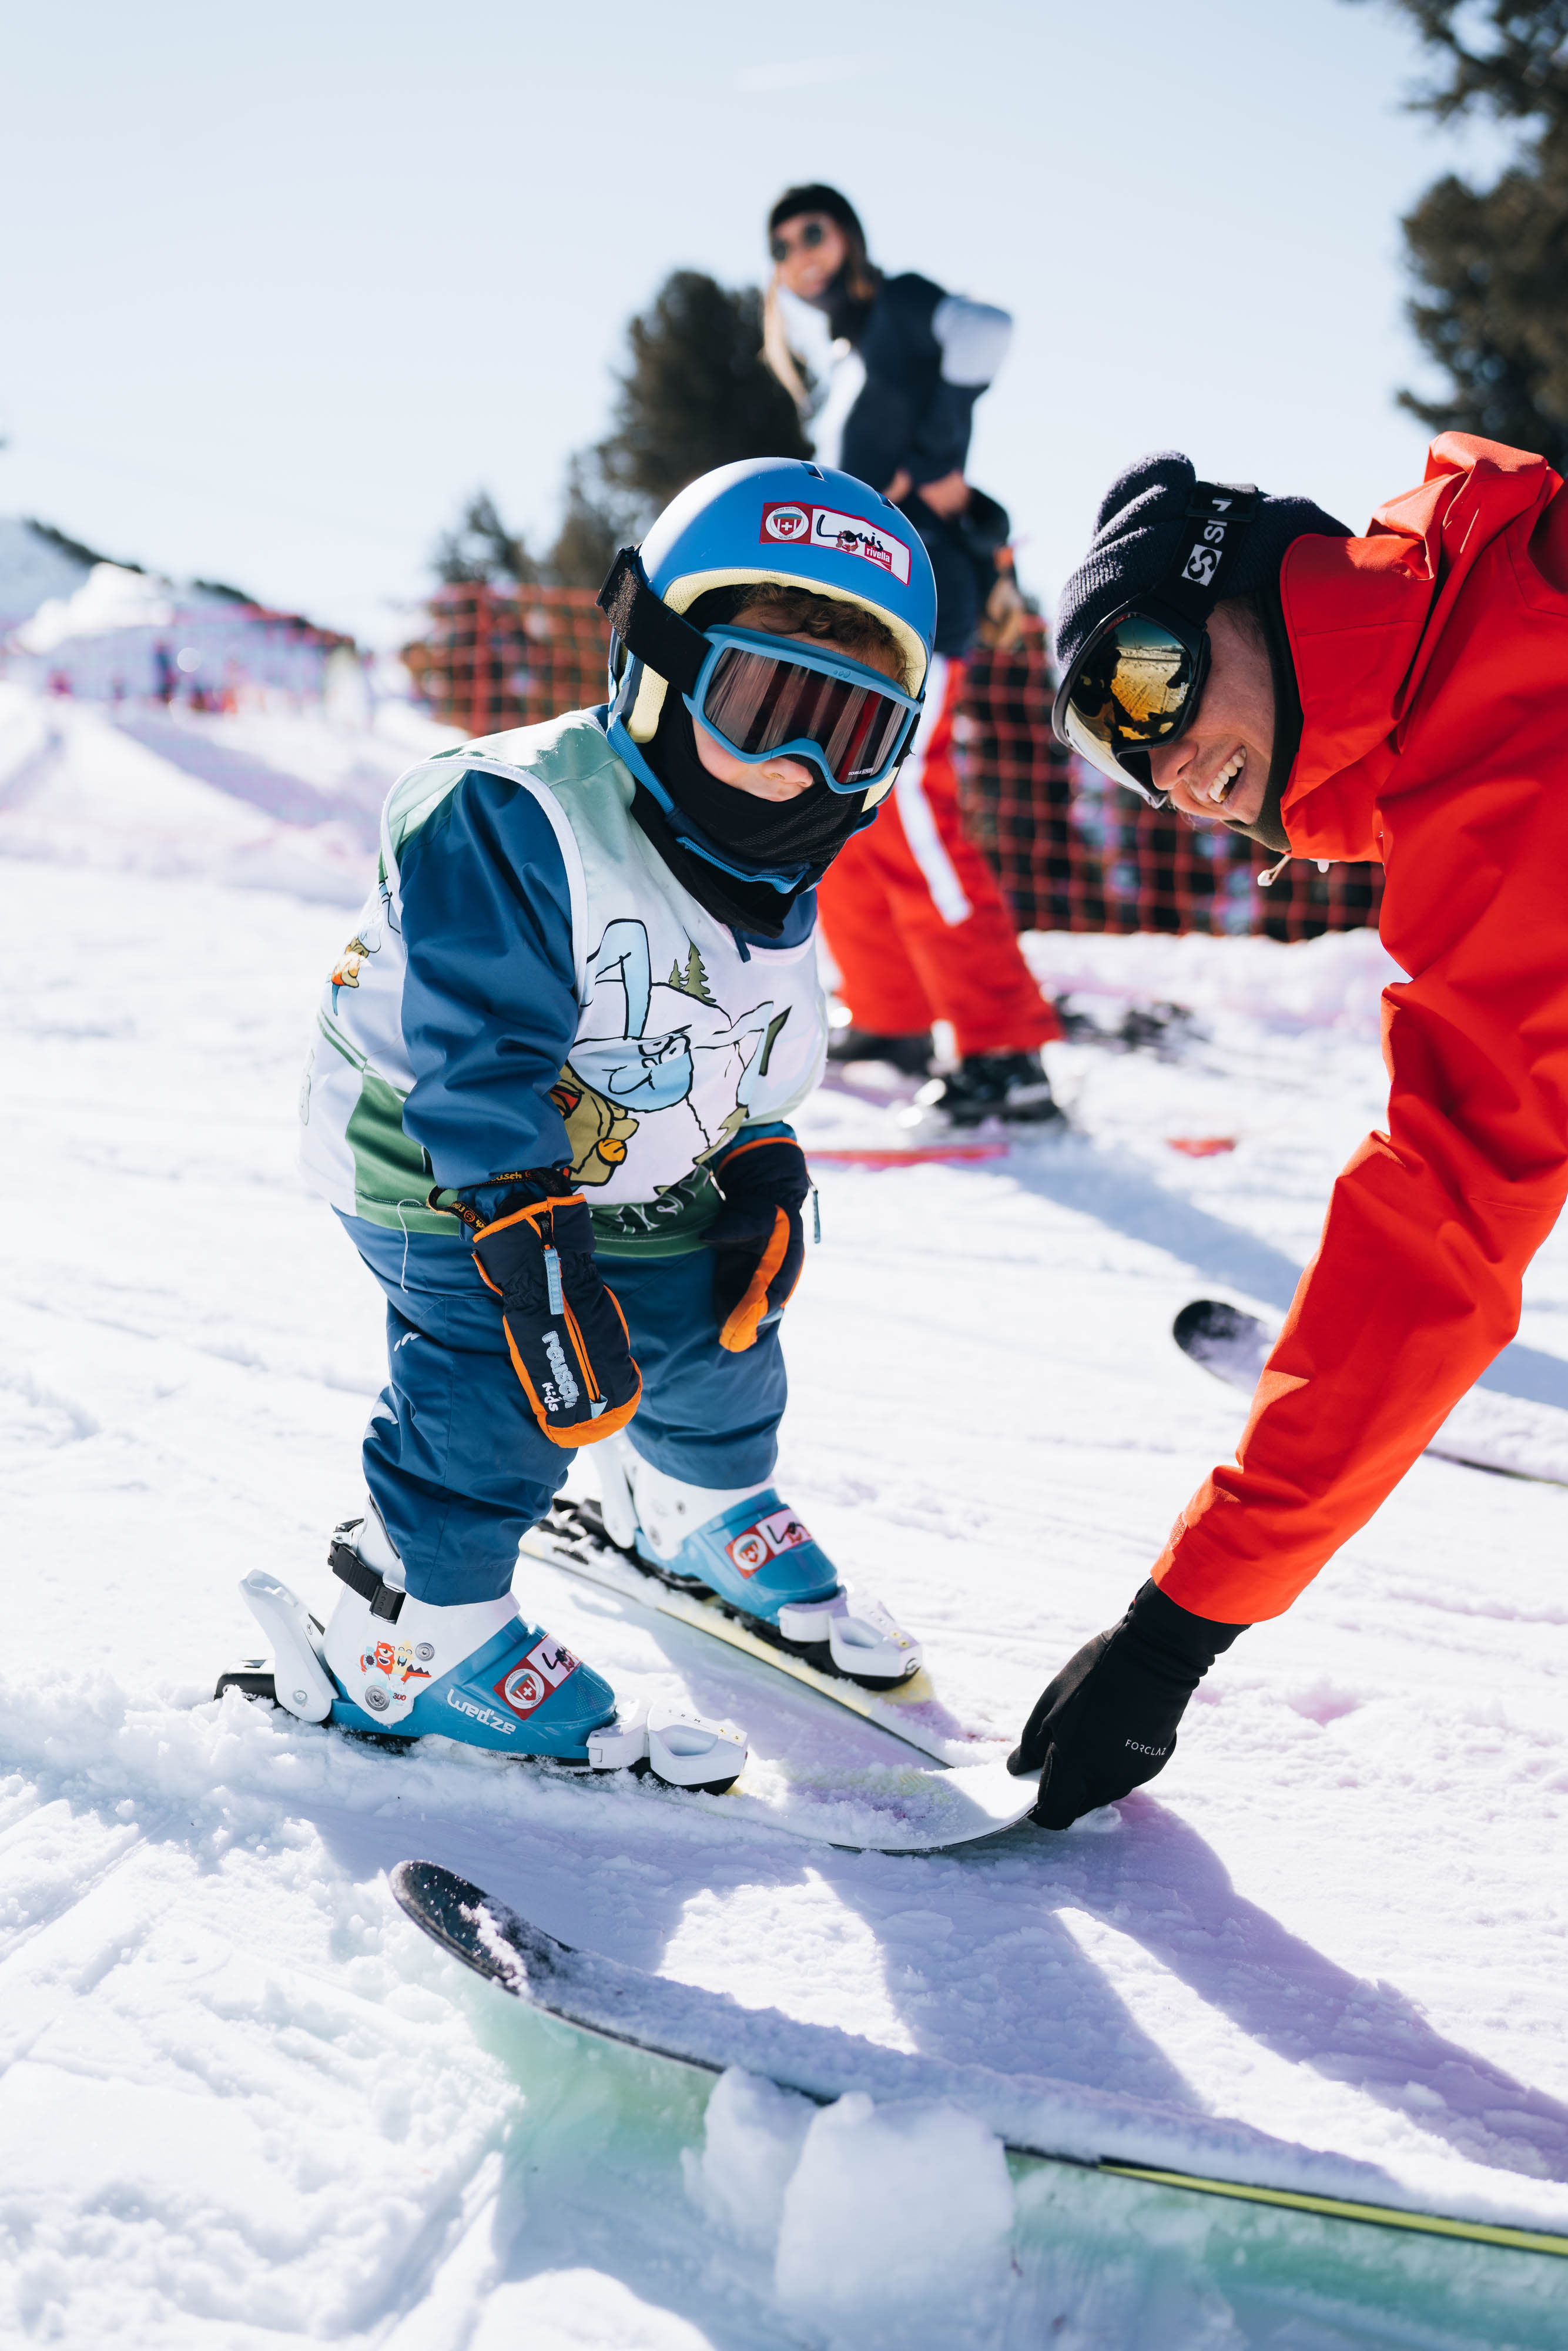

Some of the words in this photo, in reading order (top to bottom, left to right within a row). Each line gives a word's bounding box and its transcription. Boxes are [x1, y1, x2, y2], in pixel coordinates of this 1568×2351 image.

[816, 514, 883, 551] Louis
[866, 547, 890, 562] rivella
[542, 1331, 579, 1409] reusch
[1125, 1739, 1167, 1756] FORCLAZ
